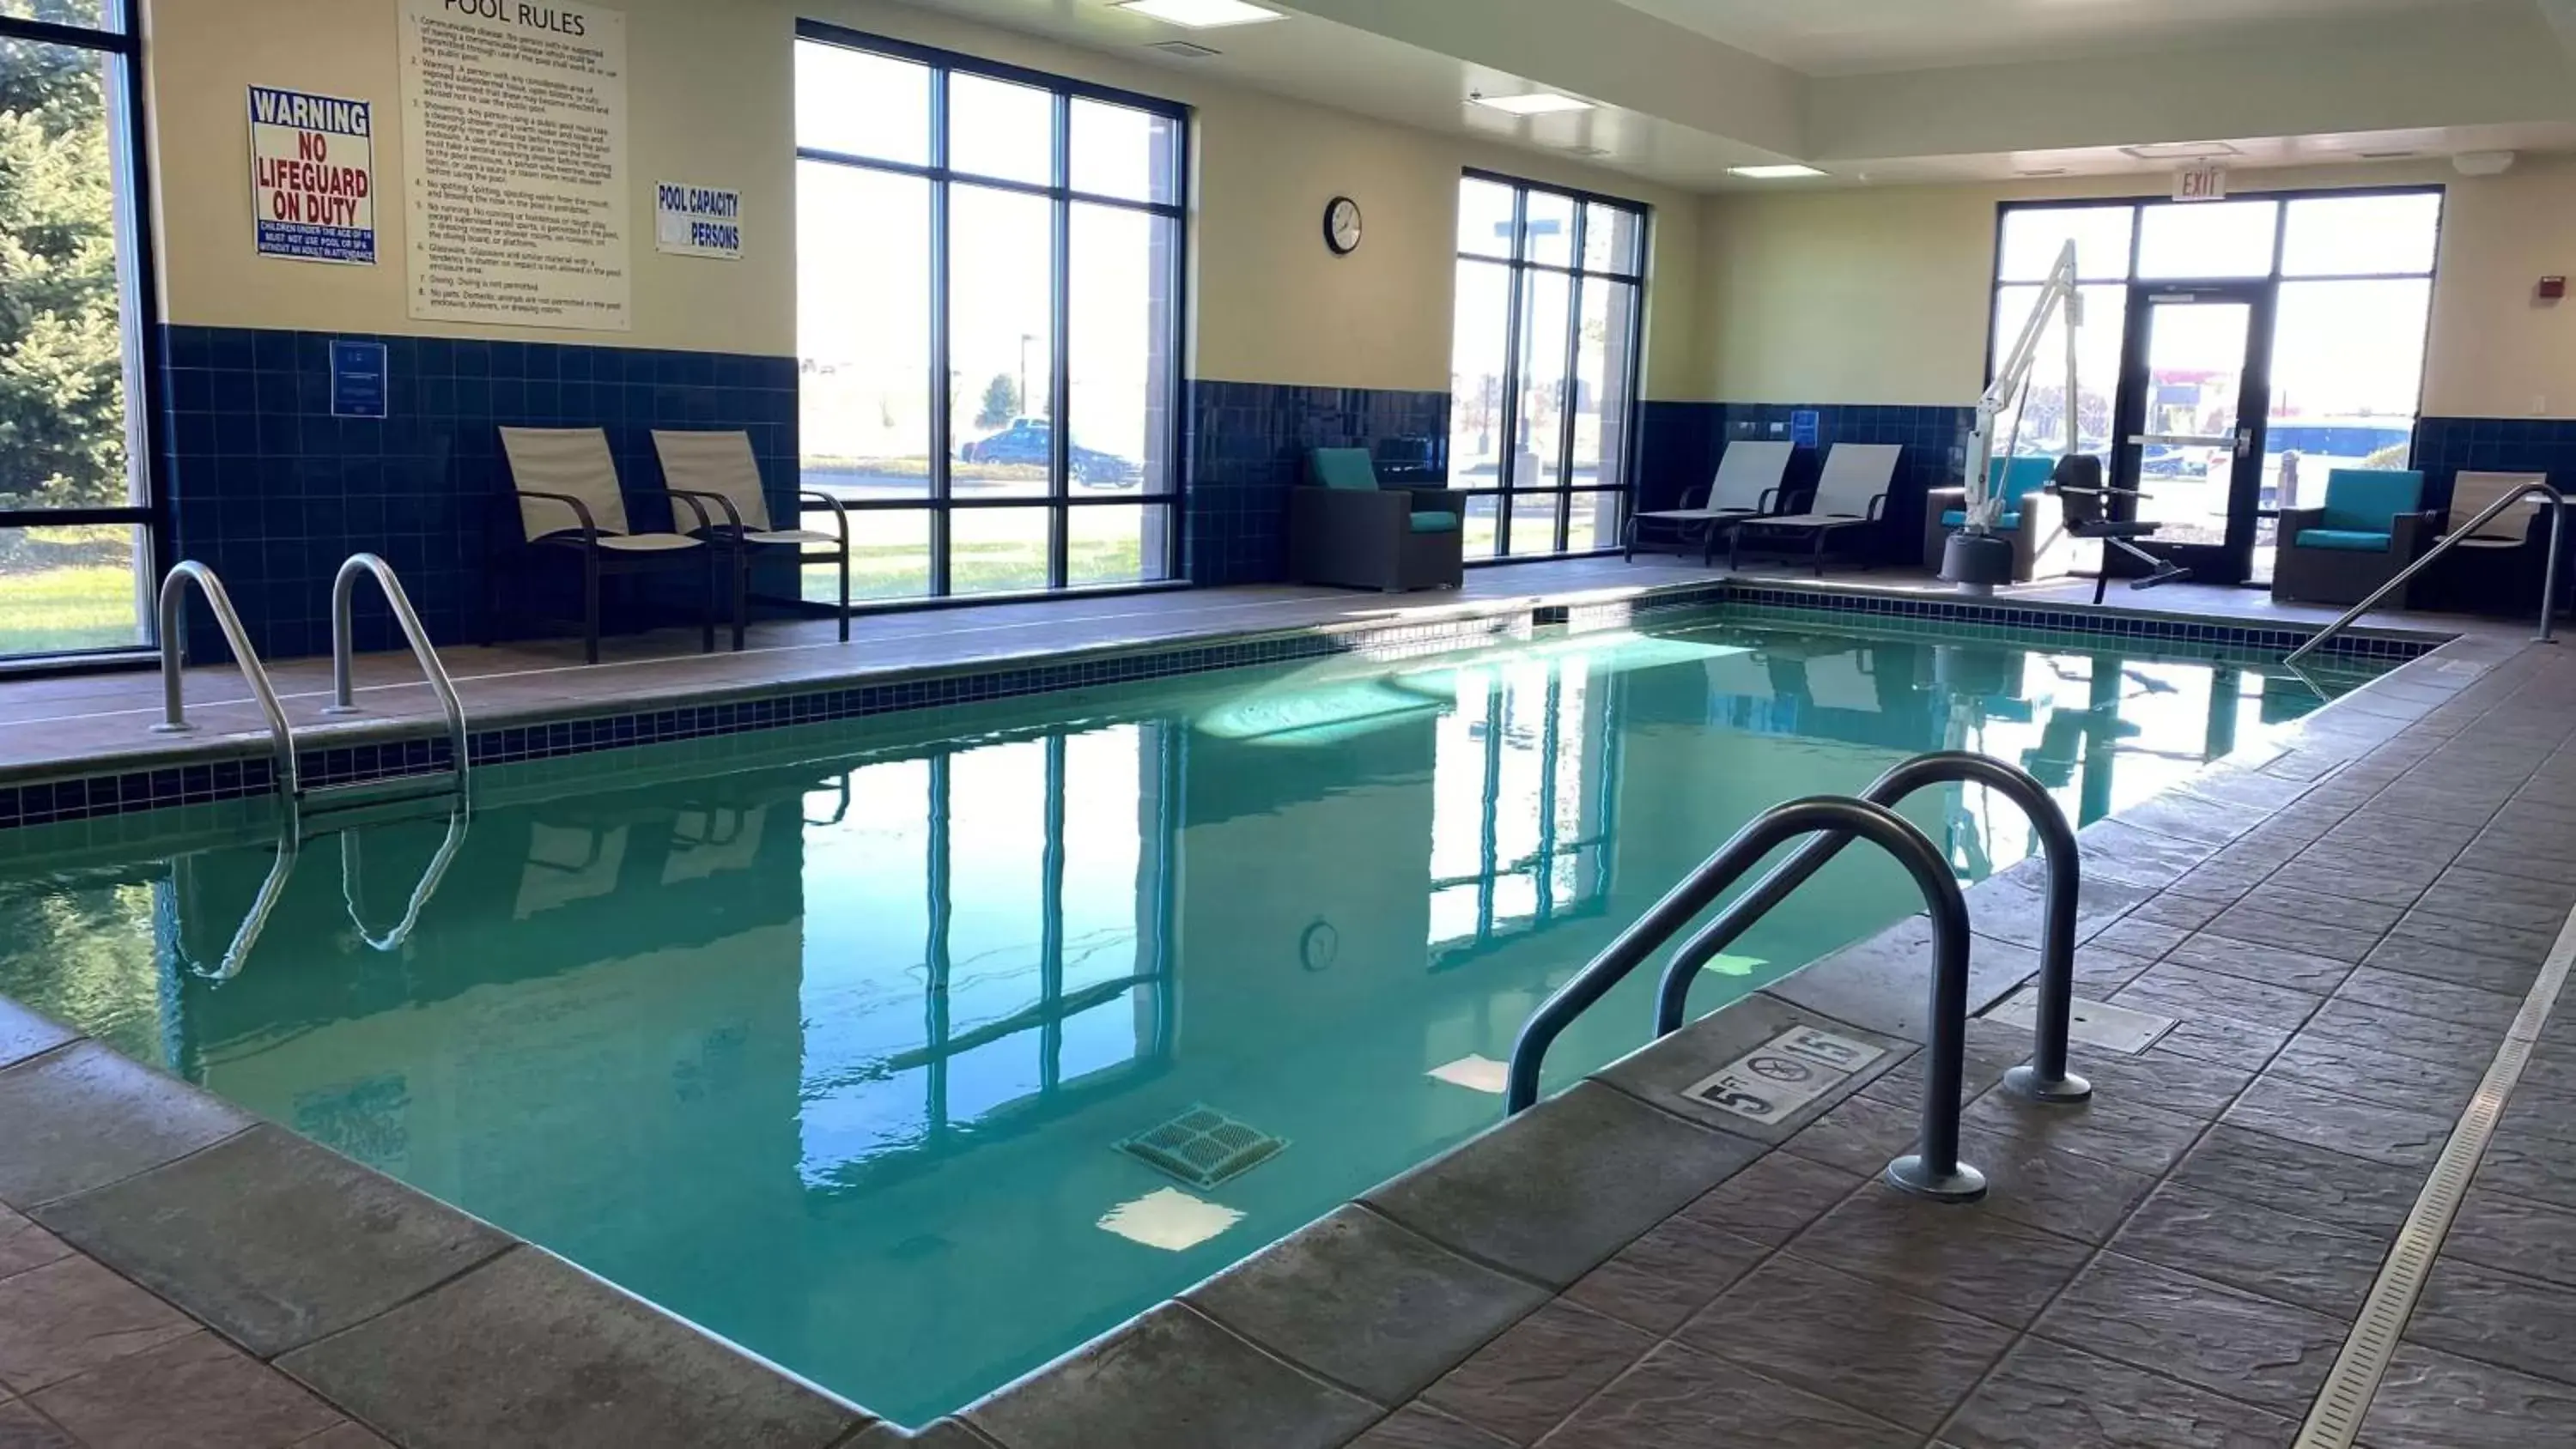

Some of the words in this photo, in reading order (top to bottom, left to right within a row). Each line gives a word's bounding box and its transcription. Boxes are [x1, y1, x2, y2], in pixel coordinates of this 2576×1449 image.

[519, 3, 585, 36] RULES
[254, 90, 367, 135] WARNING
[298, 130, 326, 162] NO
[259, 157, 368, 197] LIFEGUARD
[2182, 171, 2220, 197] EXIT
[273, 191, 300, 221] ON
[307, 194, 356, 227] DUTY
[659, 185, 687, 211] POOL
[690, 188, 738, 216] CAPACITY
[691, 221, 739, 250] PERSONS
[1701, 1084, 1775, 1115] 5
